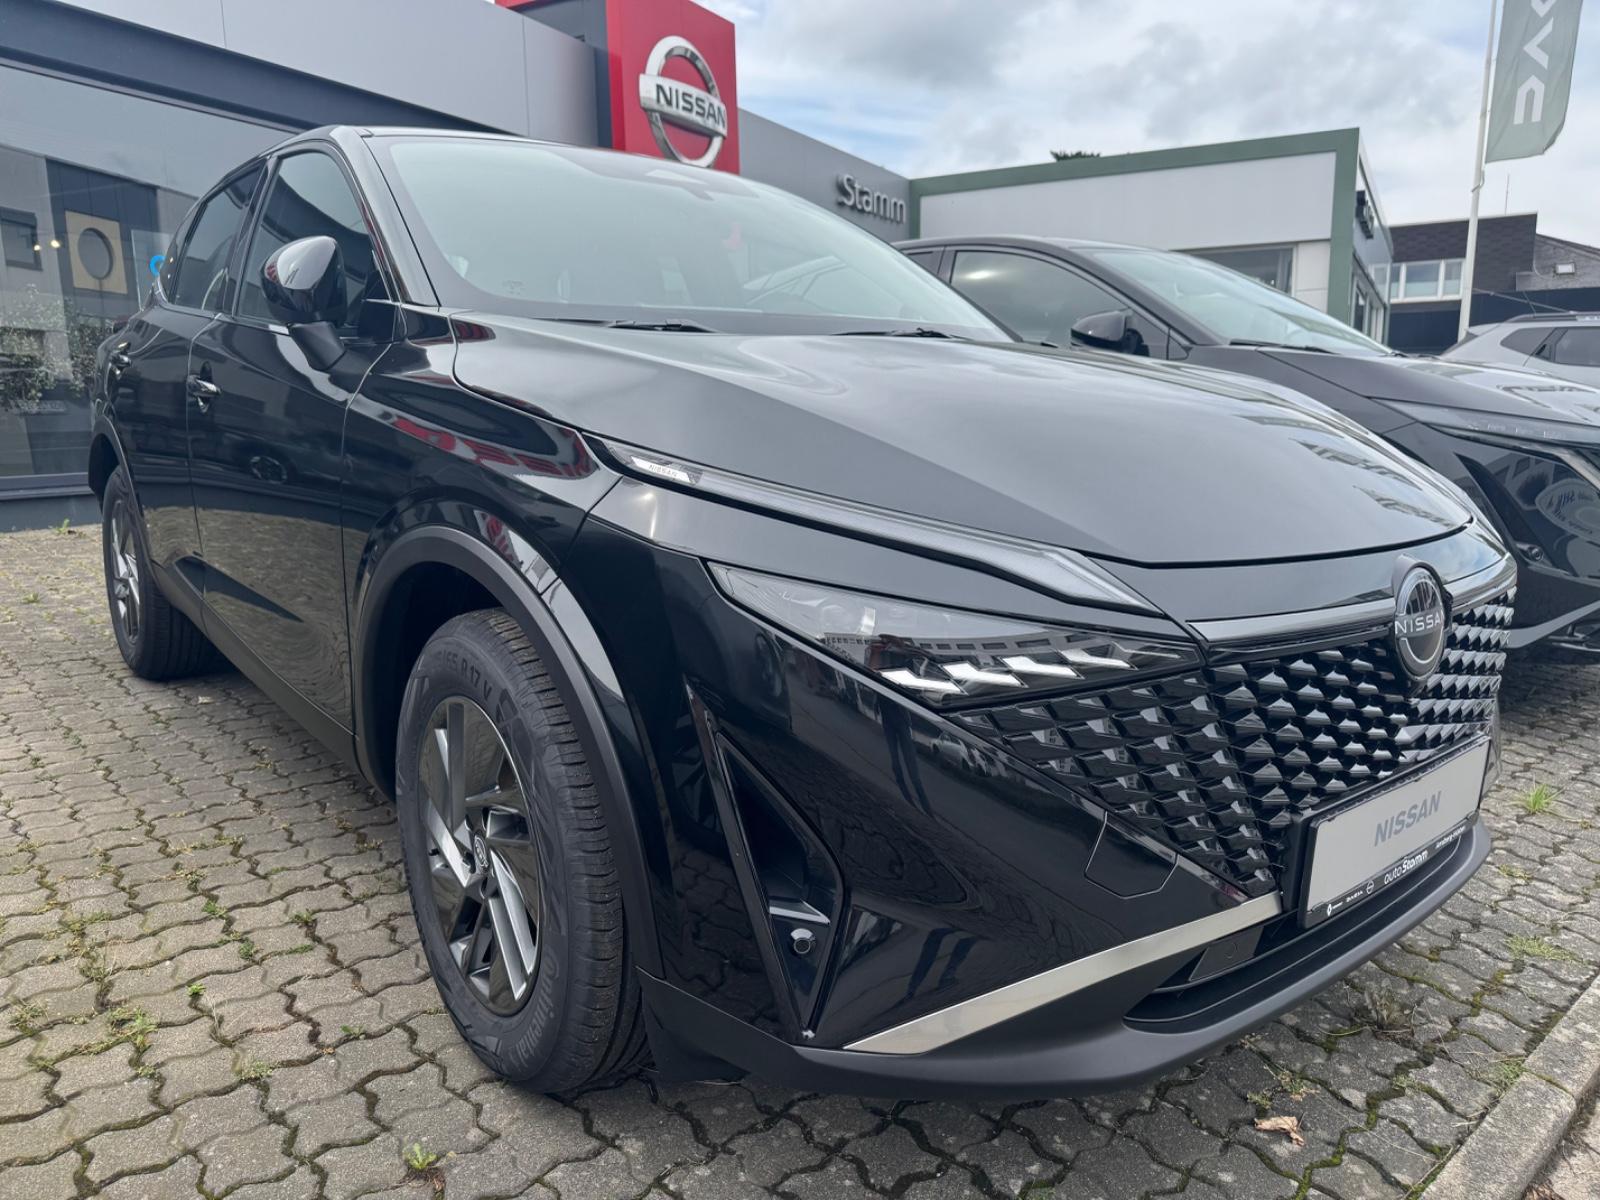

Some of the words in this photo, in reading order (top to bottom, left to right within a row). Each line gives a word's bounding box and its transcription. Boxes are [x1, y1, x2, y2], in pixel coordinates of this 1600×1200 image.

[655, 83, 726, 128] NISSAN
[839, 175, 906, 224] Stamm
[1374, 790, 1442, 847] NISSAN
